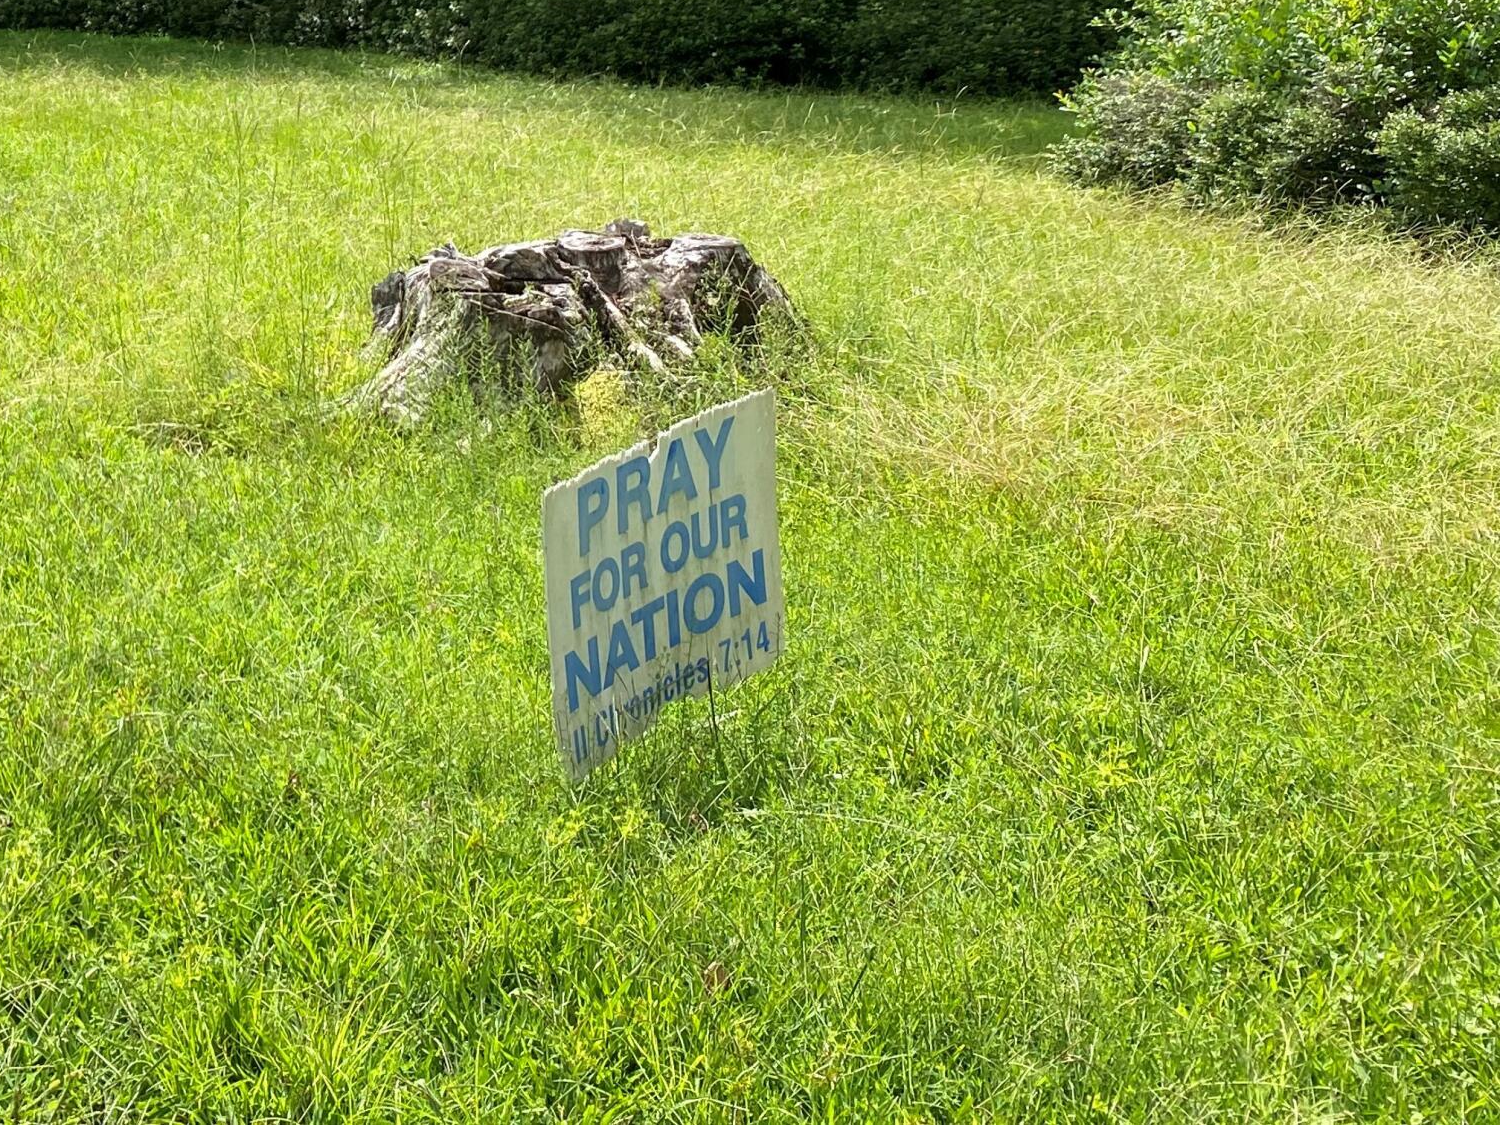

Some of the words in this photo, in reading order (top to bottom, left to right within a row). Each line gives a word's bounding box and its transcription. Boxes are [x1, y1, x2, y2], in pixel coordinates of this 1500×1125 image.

[577, 415, 735, 557] PRAY
[565, 548, 768, 714] NATION
[570, 541, 649, 631] FOR
[660, 494, 749, 573] OUR
[718, 620, 770, 673] 7:14
